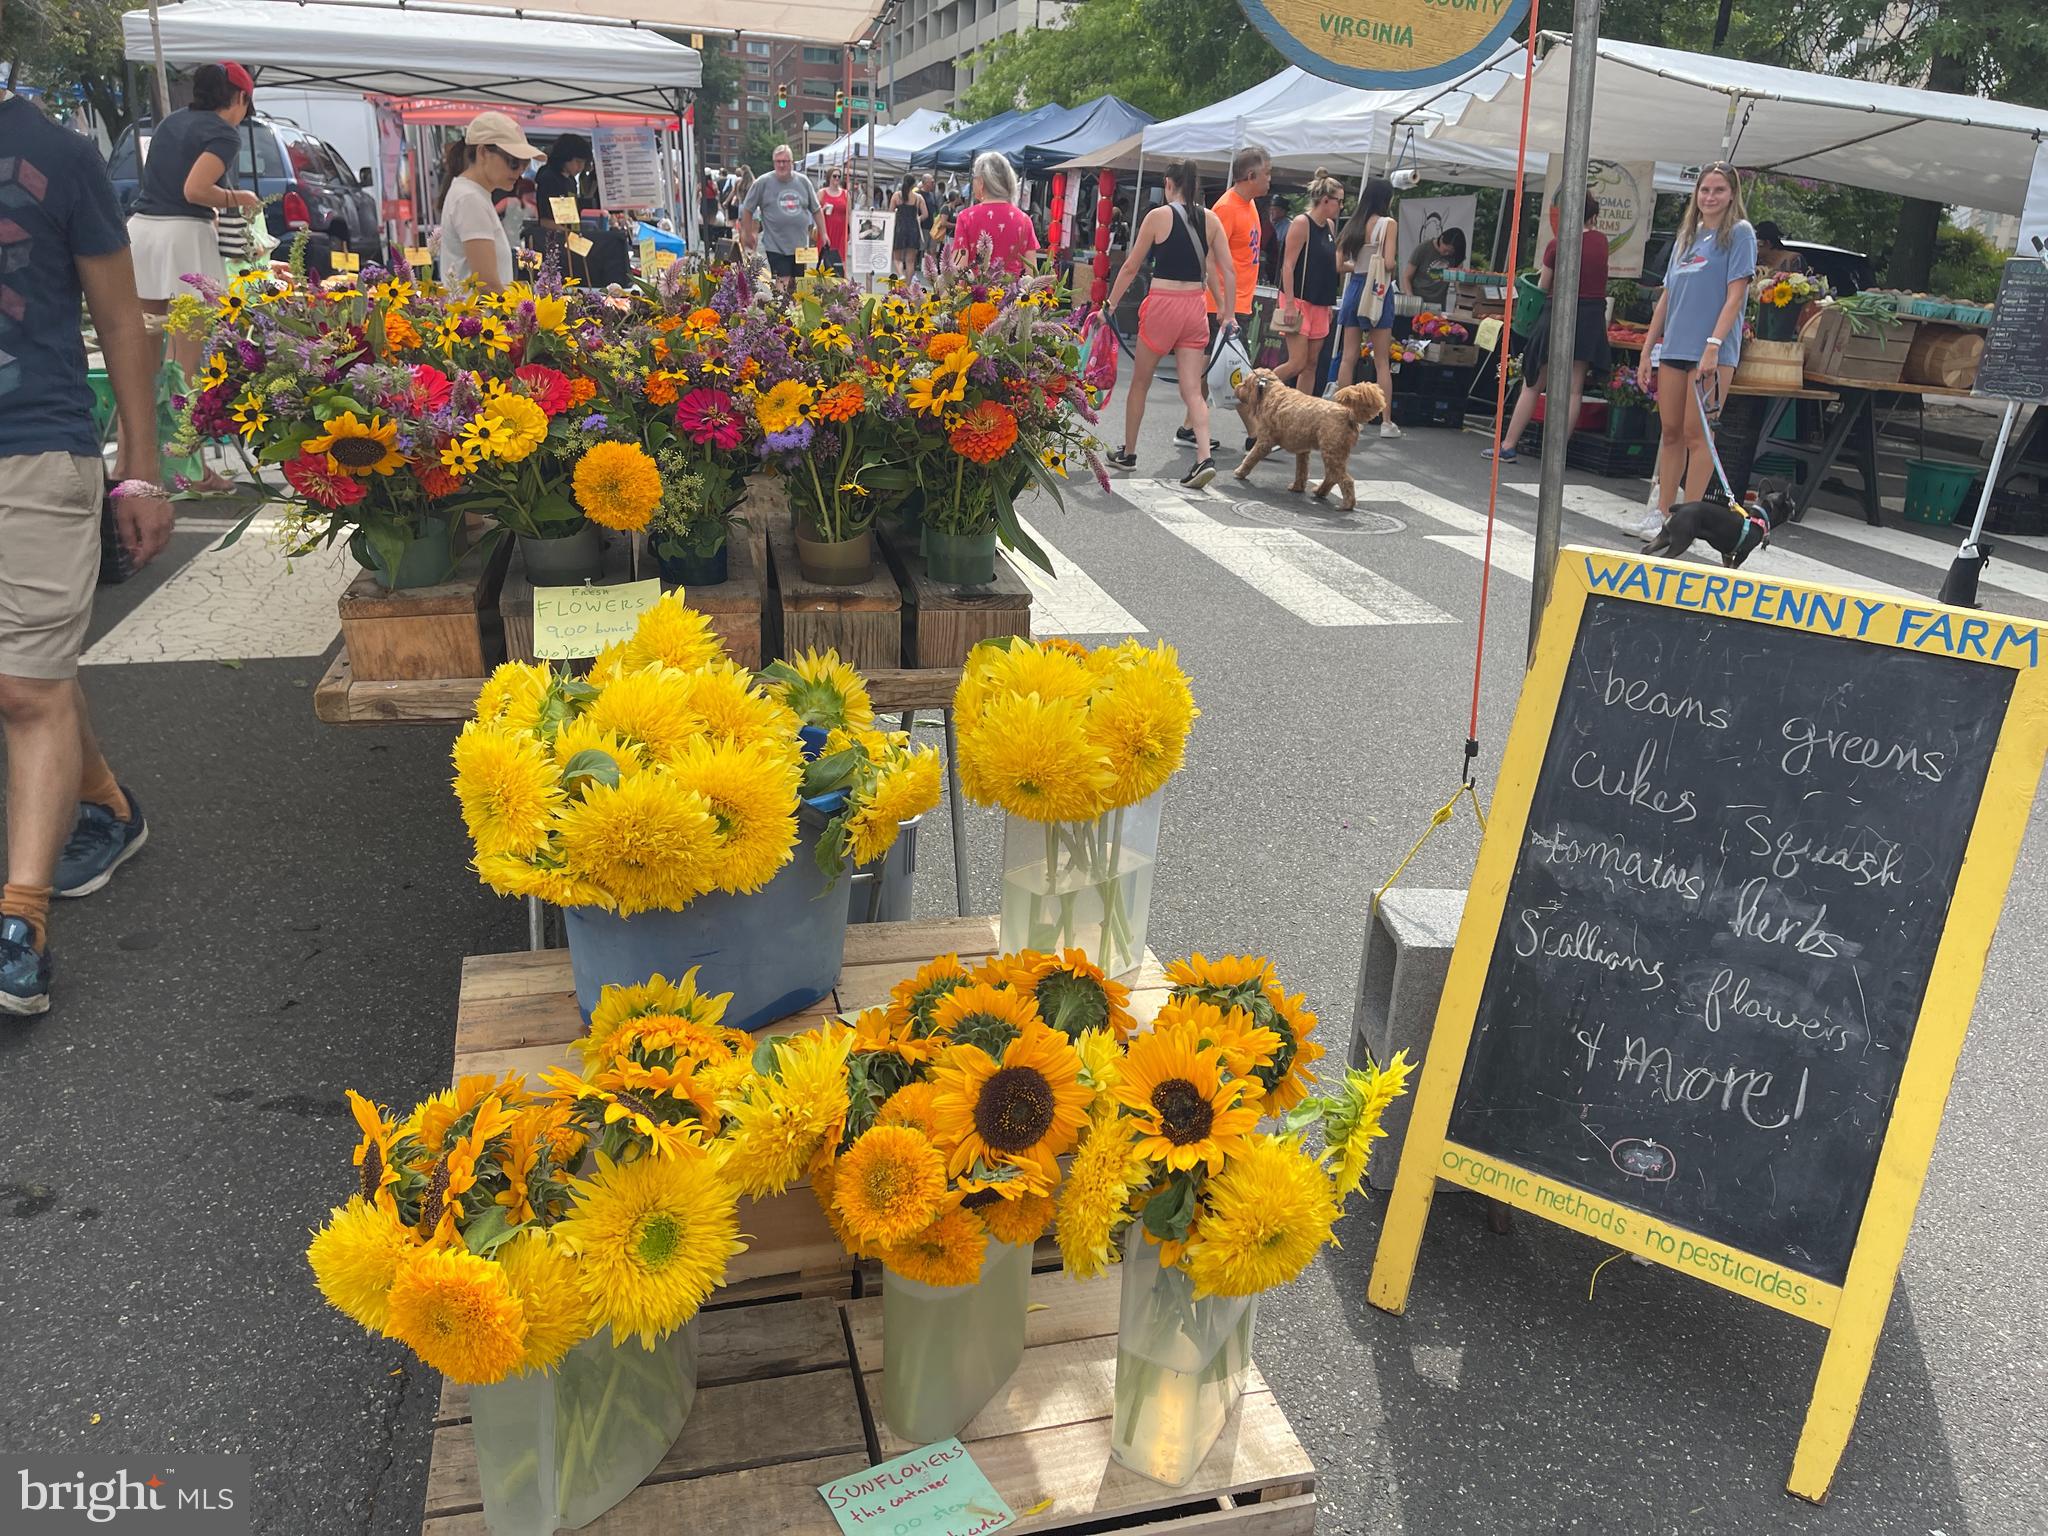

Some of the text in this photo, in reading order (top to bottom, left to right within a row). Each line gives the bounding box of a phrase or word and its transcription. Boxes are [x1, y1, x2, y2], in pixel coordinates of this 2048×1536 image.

[1424, 0, 1502, 15] UNTY
[1319, 13, 1414, 48] VIRGINIA
[1597, 196, 1632, 209] OMAC
[1599, 208, 1633, 220] TABLE
[537, 597, 645, 617] FLOWERS
[1584, 556, 2039, 668] WATERPENNY FARM
[1603, 670, 1946, 784] beans greens
[1704, 968, 1848, 1052] flowers
[1441, 1149, 1808, 1308] organic methods no pesticides
[850, 1473, 949, 1524] this container
